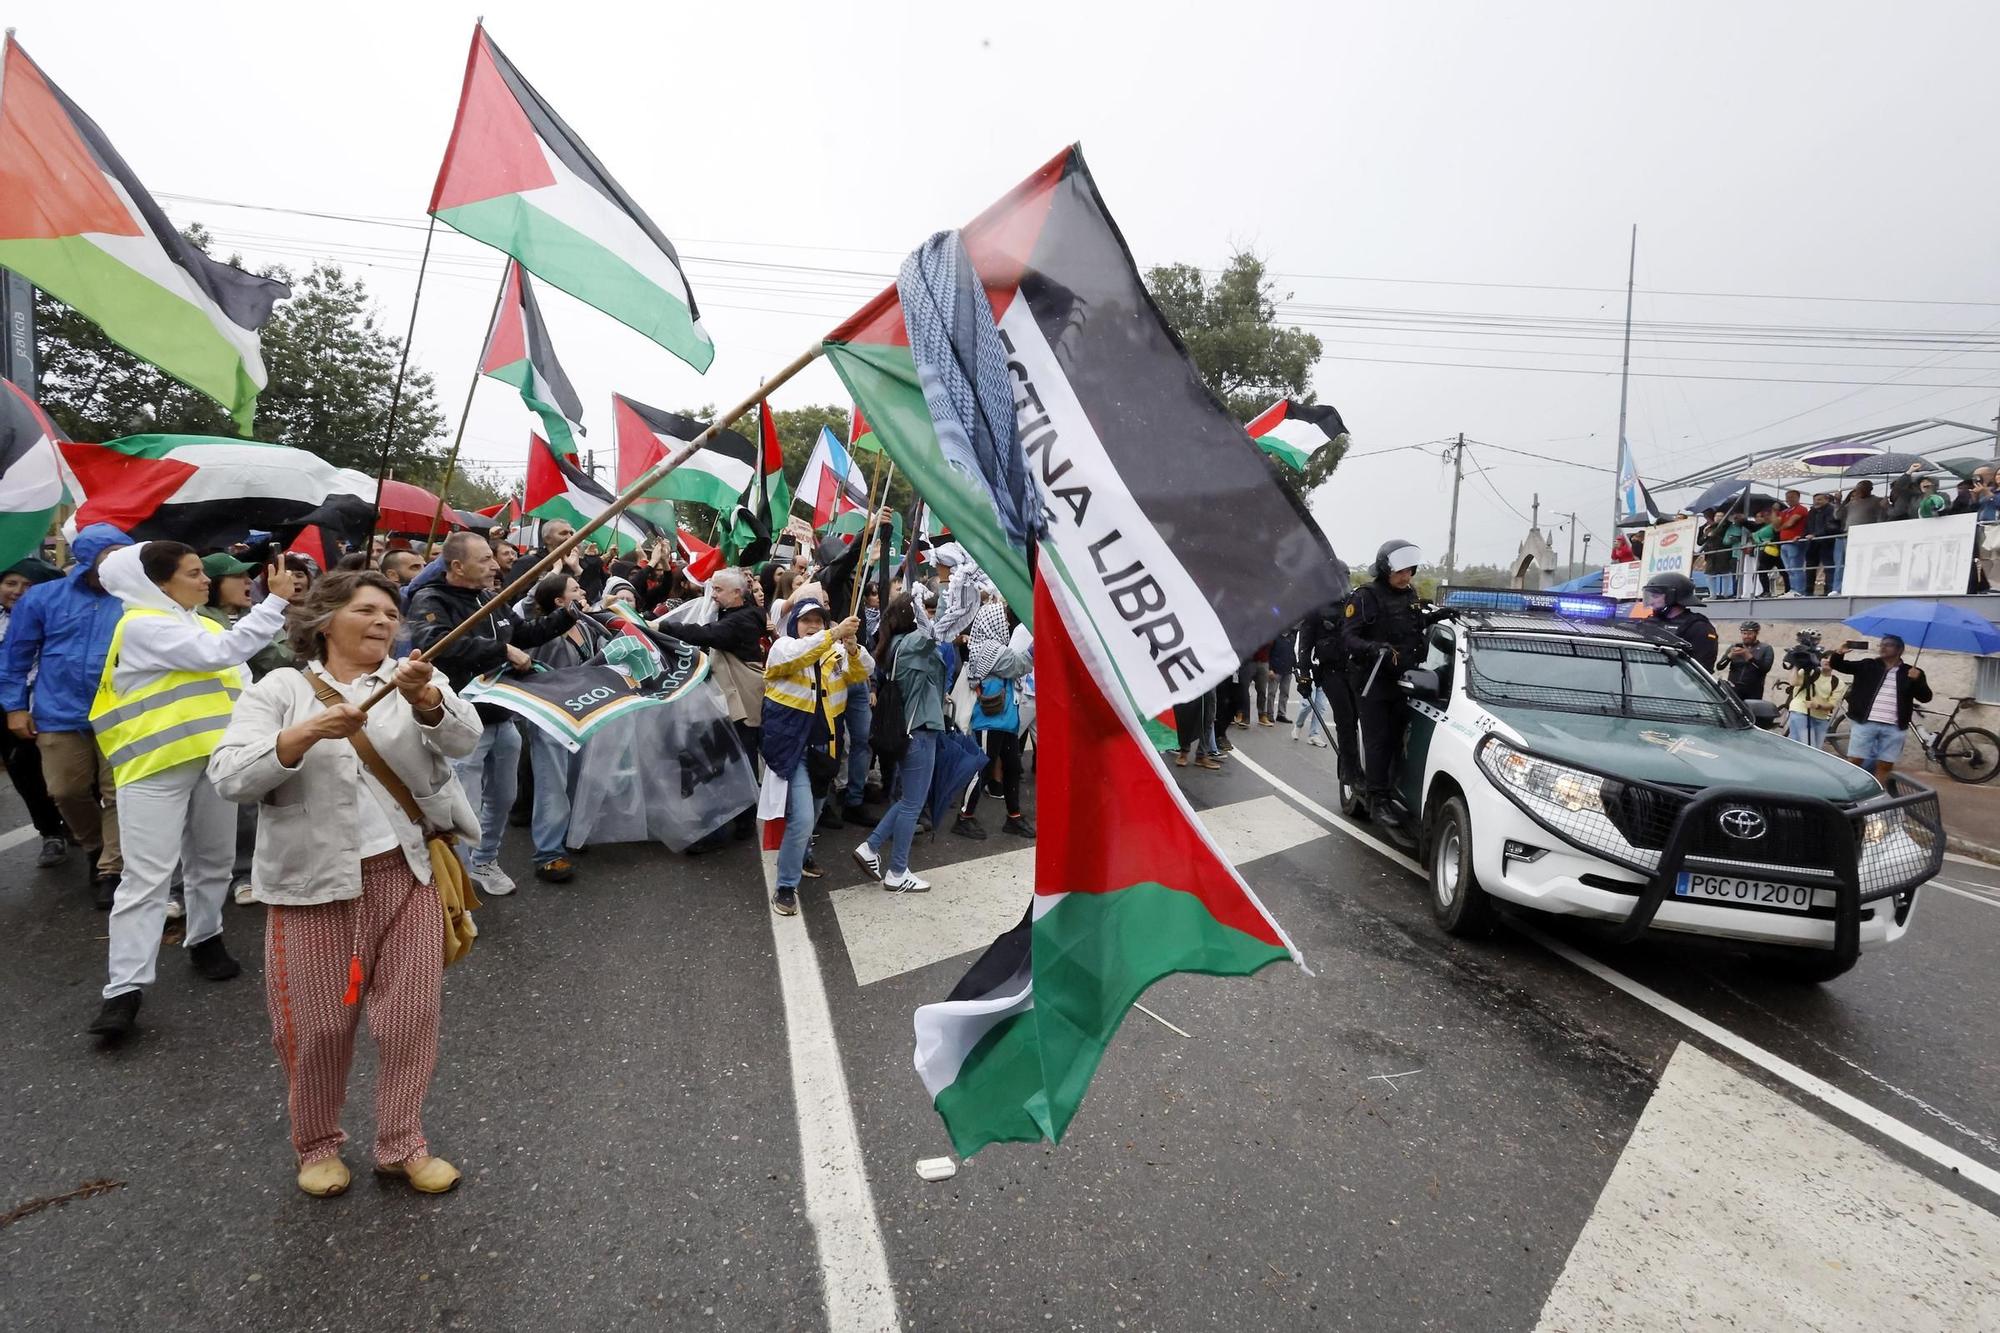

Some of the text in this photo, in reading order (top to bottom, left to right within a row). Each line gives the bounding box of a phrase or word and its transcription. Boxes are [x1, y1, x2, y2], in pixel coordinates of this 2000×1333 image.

[13, 311, 34, 373] galicia
[1000, 328, 1205, 694] TINA LIBRE
[1691, 875, 1731, 897] PGC
[1735, 880, 1789, 904] 0120
